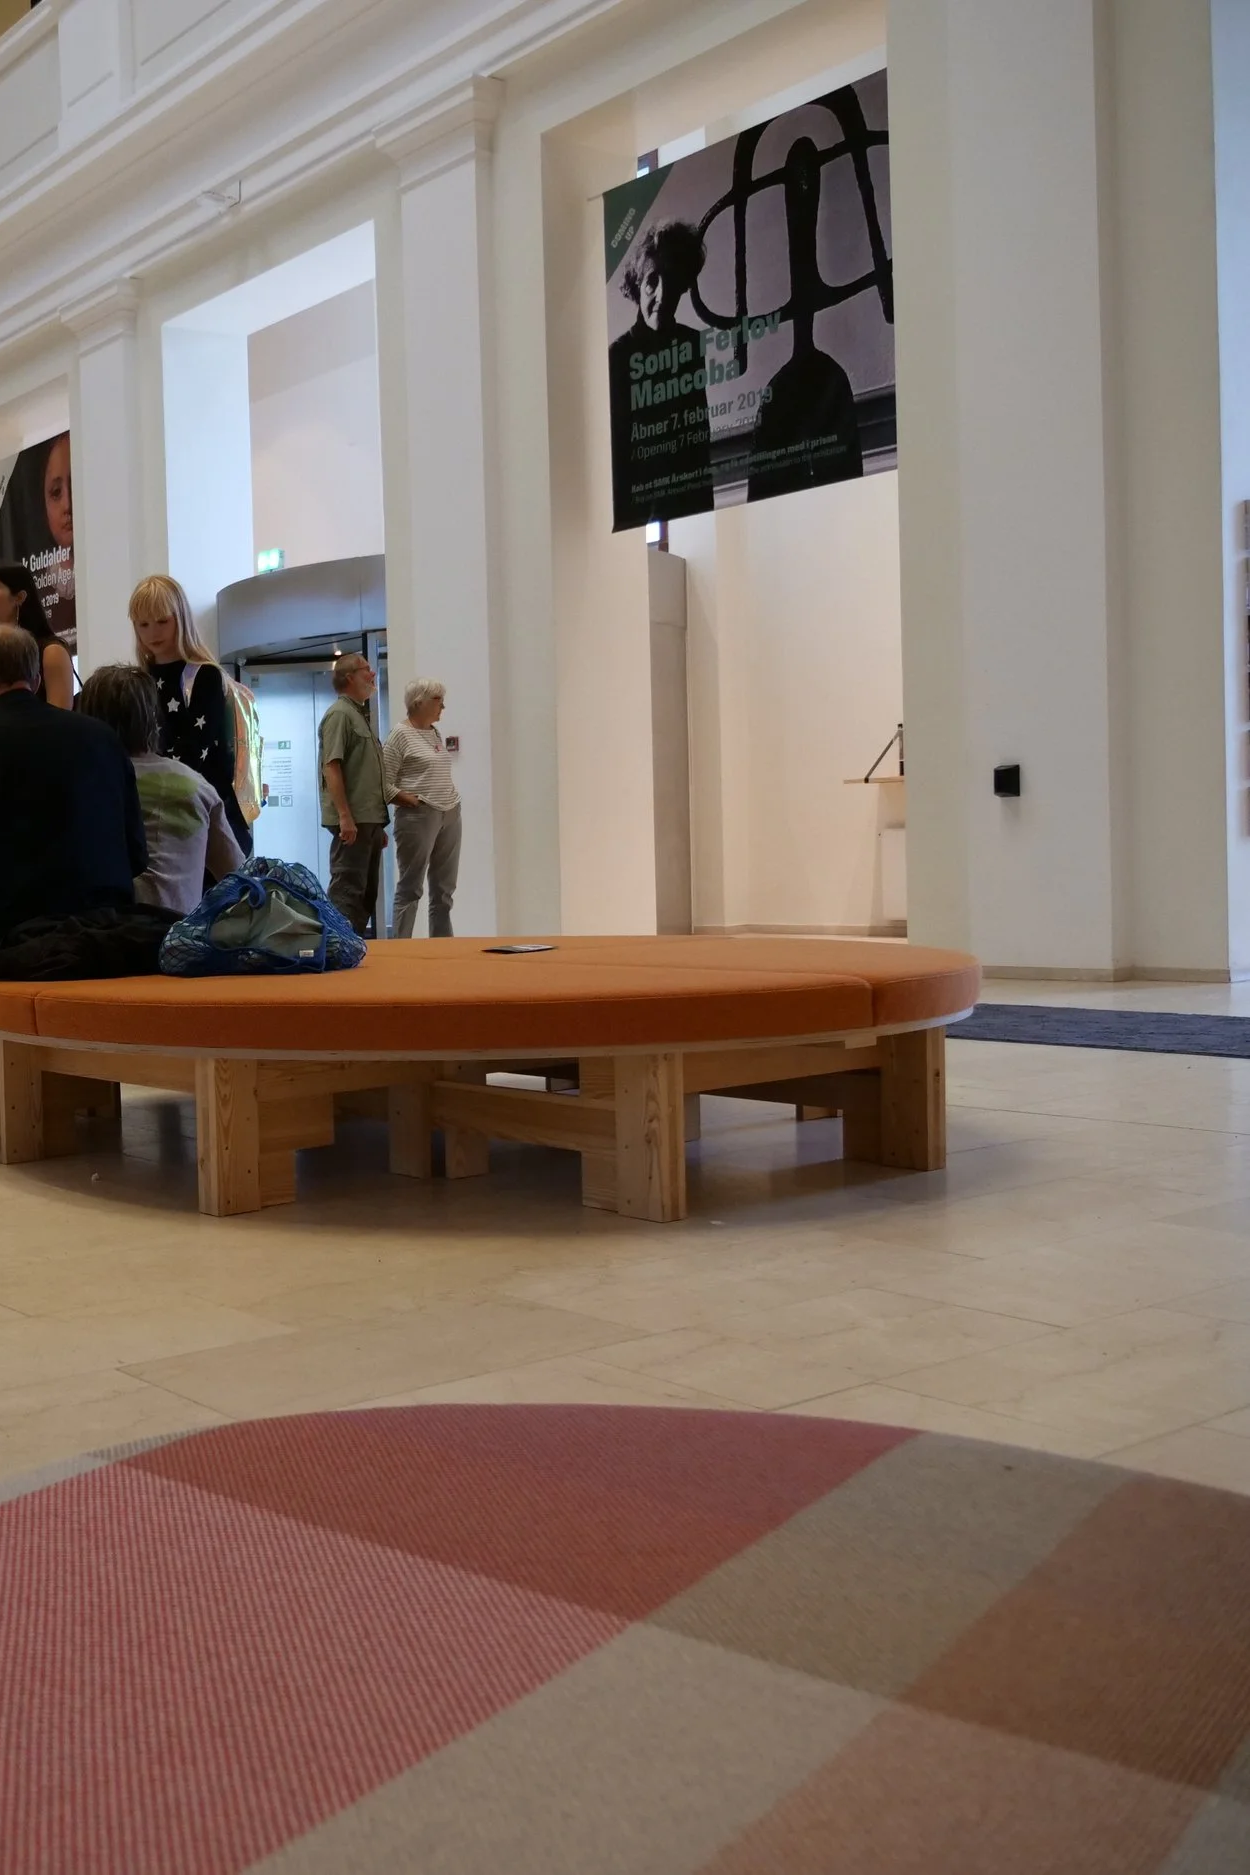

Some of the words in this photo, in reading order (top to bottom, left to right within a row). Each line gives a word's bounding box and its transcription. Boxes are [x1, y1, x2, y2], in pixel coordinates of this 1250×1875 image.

[611, 207, 636, 248] COMING
[625, 226, 634, 241] UP
[629, 338, 693, 381] Sonja
[700, 311, 781, 358] Ferlov
[630, 358, 741, 412] Mancoba
[631, 419, 669, 442] Åbner
[671, 412, 681, 430] 7.
[683, 400, 734, 427] februar
[737, 386, 773, 411] 2019
[637, 436, 677, 460] Opening
[678, 434, 685, 446] 7
[30, 545, 71, 572] Guldalder
[33, 572, 57, 590] Golden
[57, 567, 71, 585] Age
